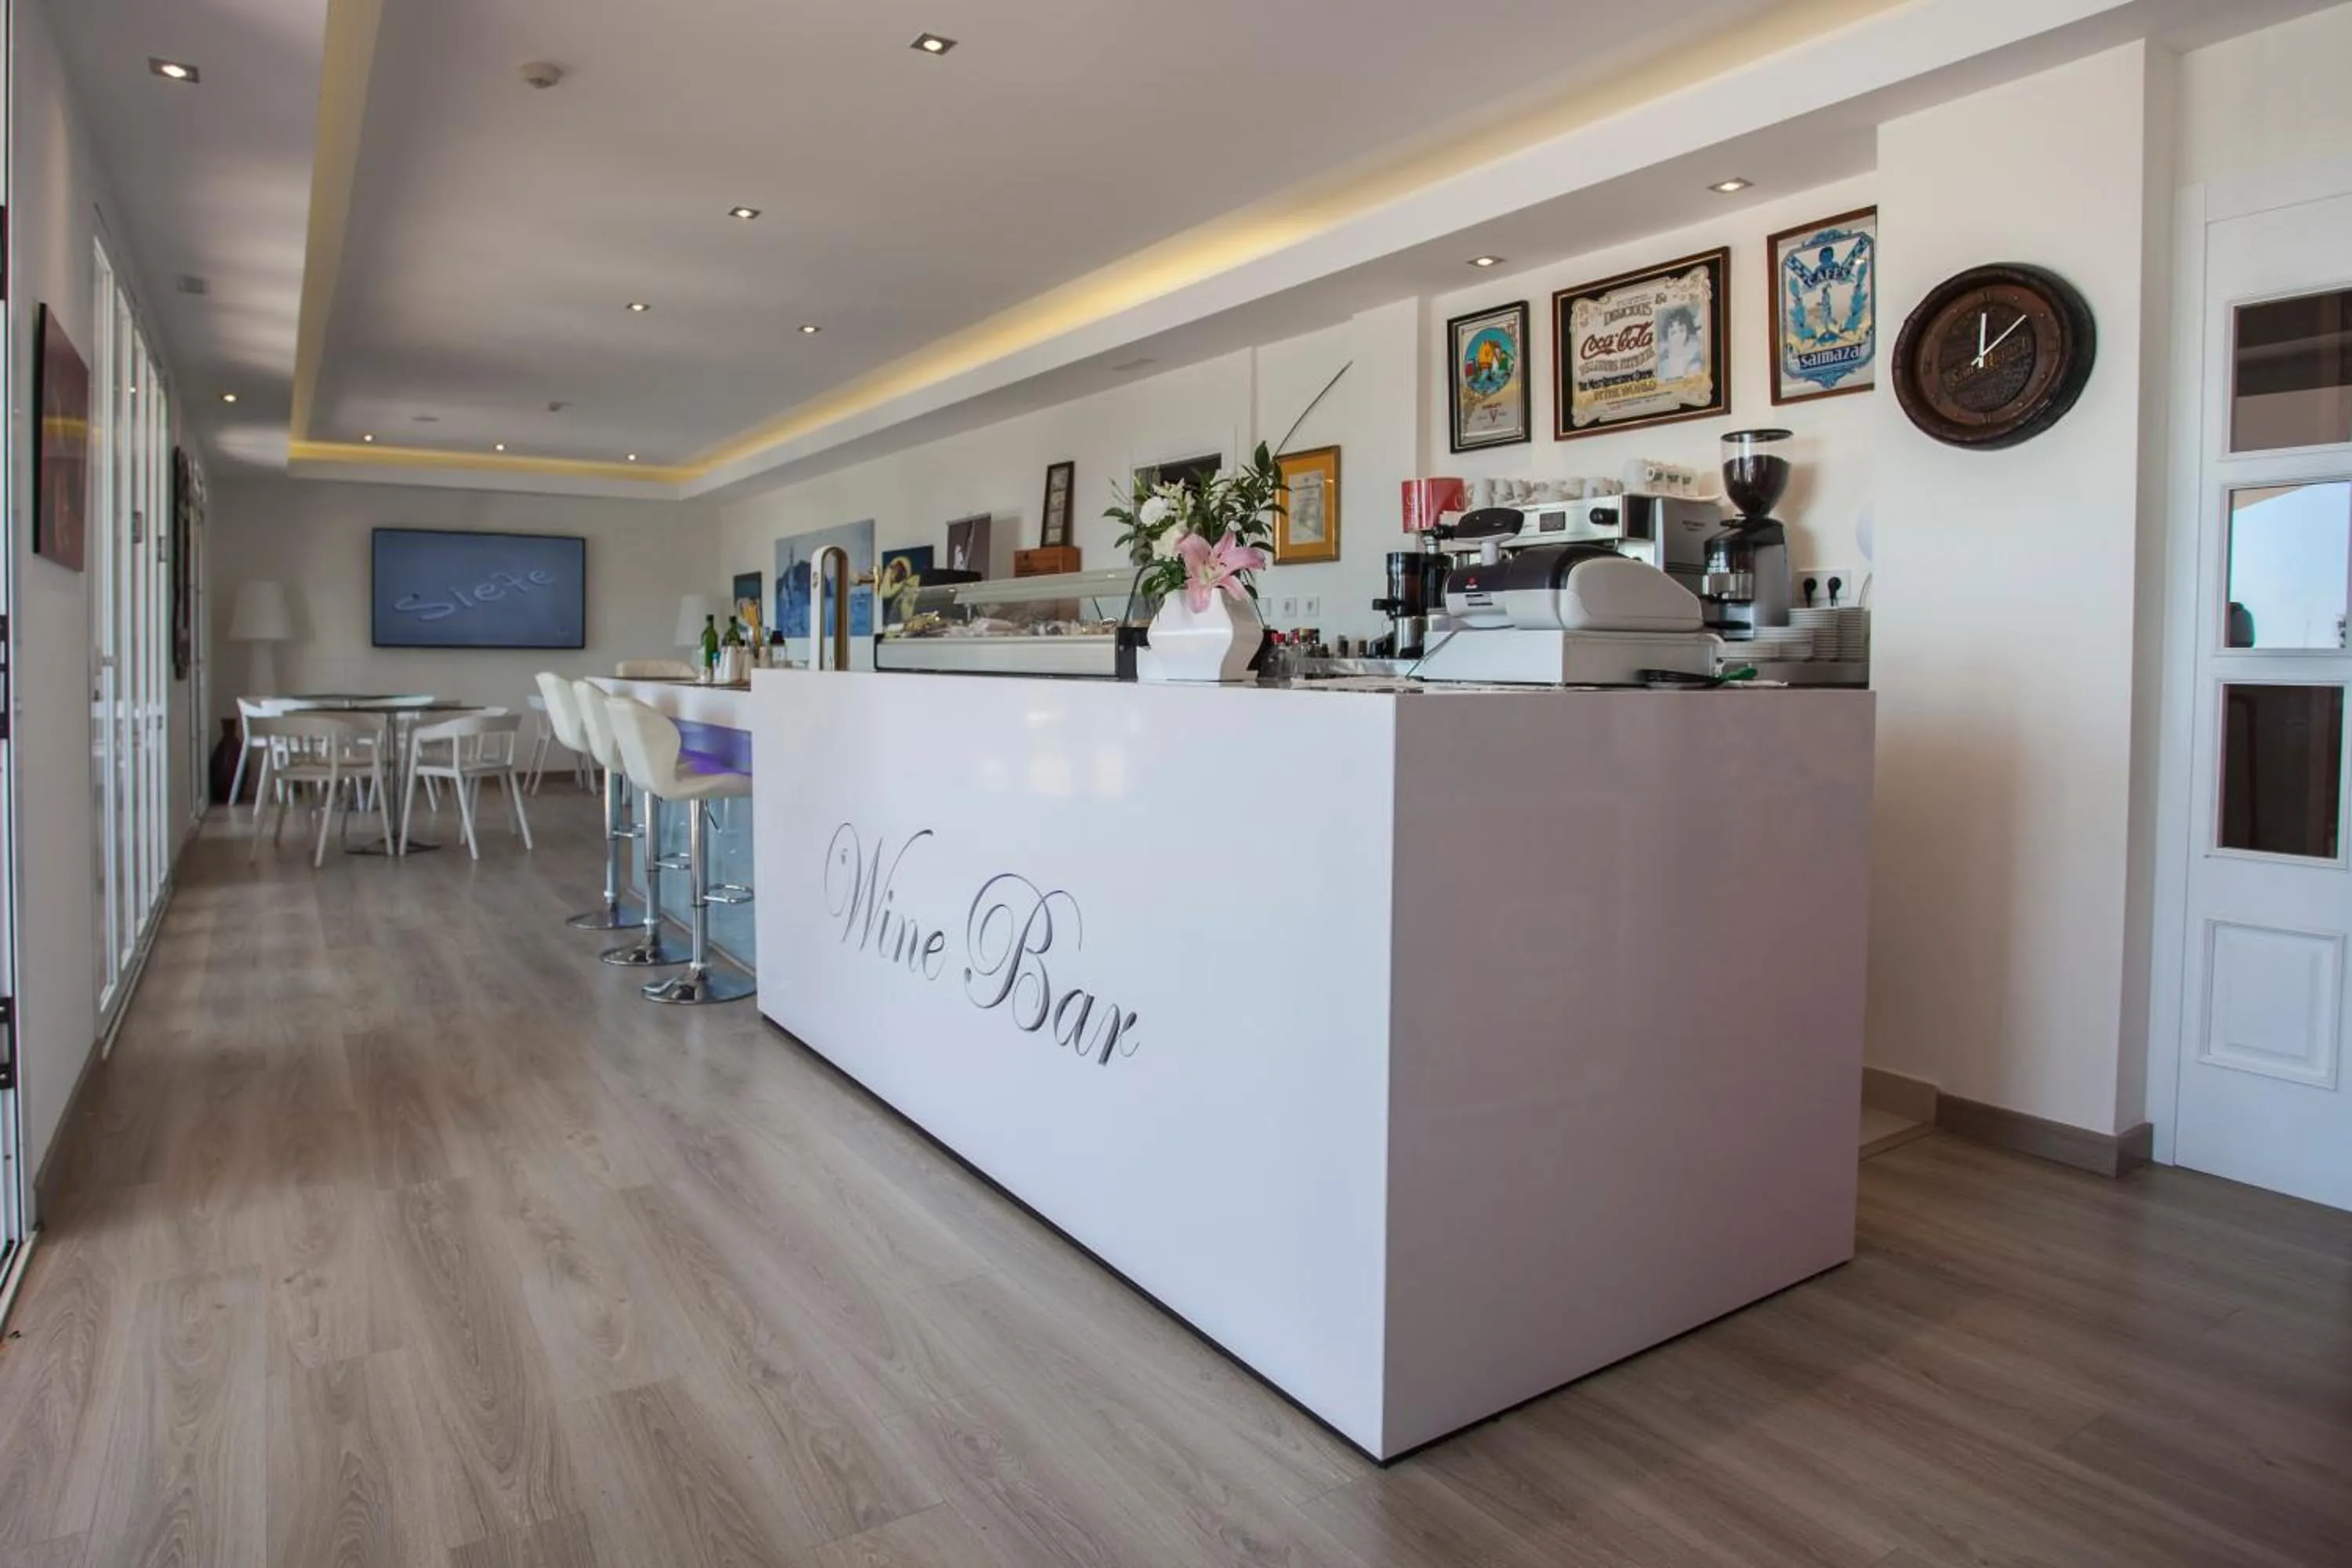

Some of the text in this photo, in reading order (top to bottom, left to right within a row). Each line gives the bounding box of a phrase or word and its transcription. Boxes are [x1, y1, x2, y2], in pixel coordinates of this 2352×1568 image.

[1581, 320, 1654, 360] Coca-Cola
[824, 822, 1141, 1067] Wine Bar
